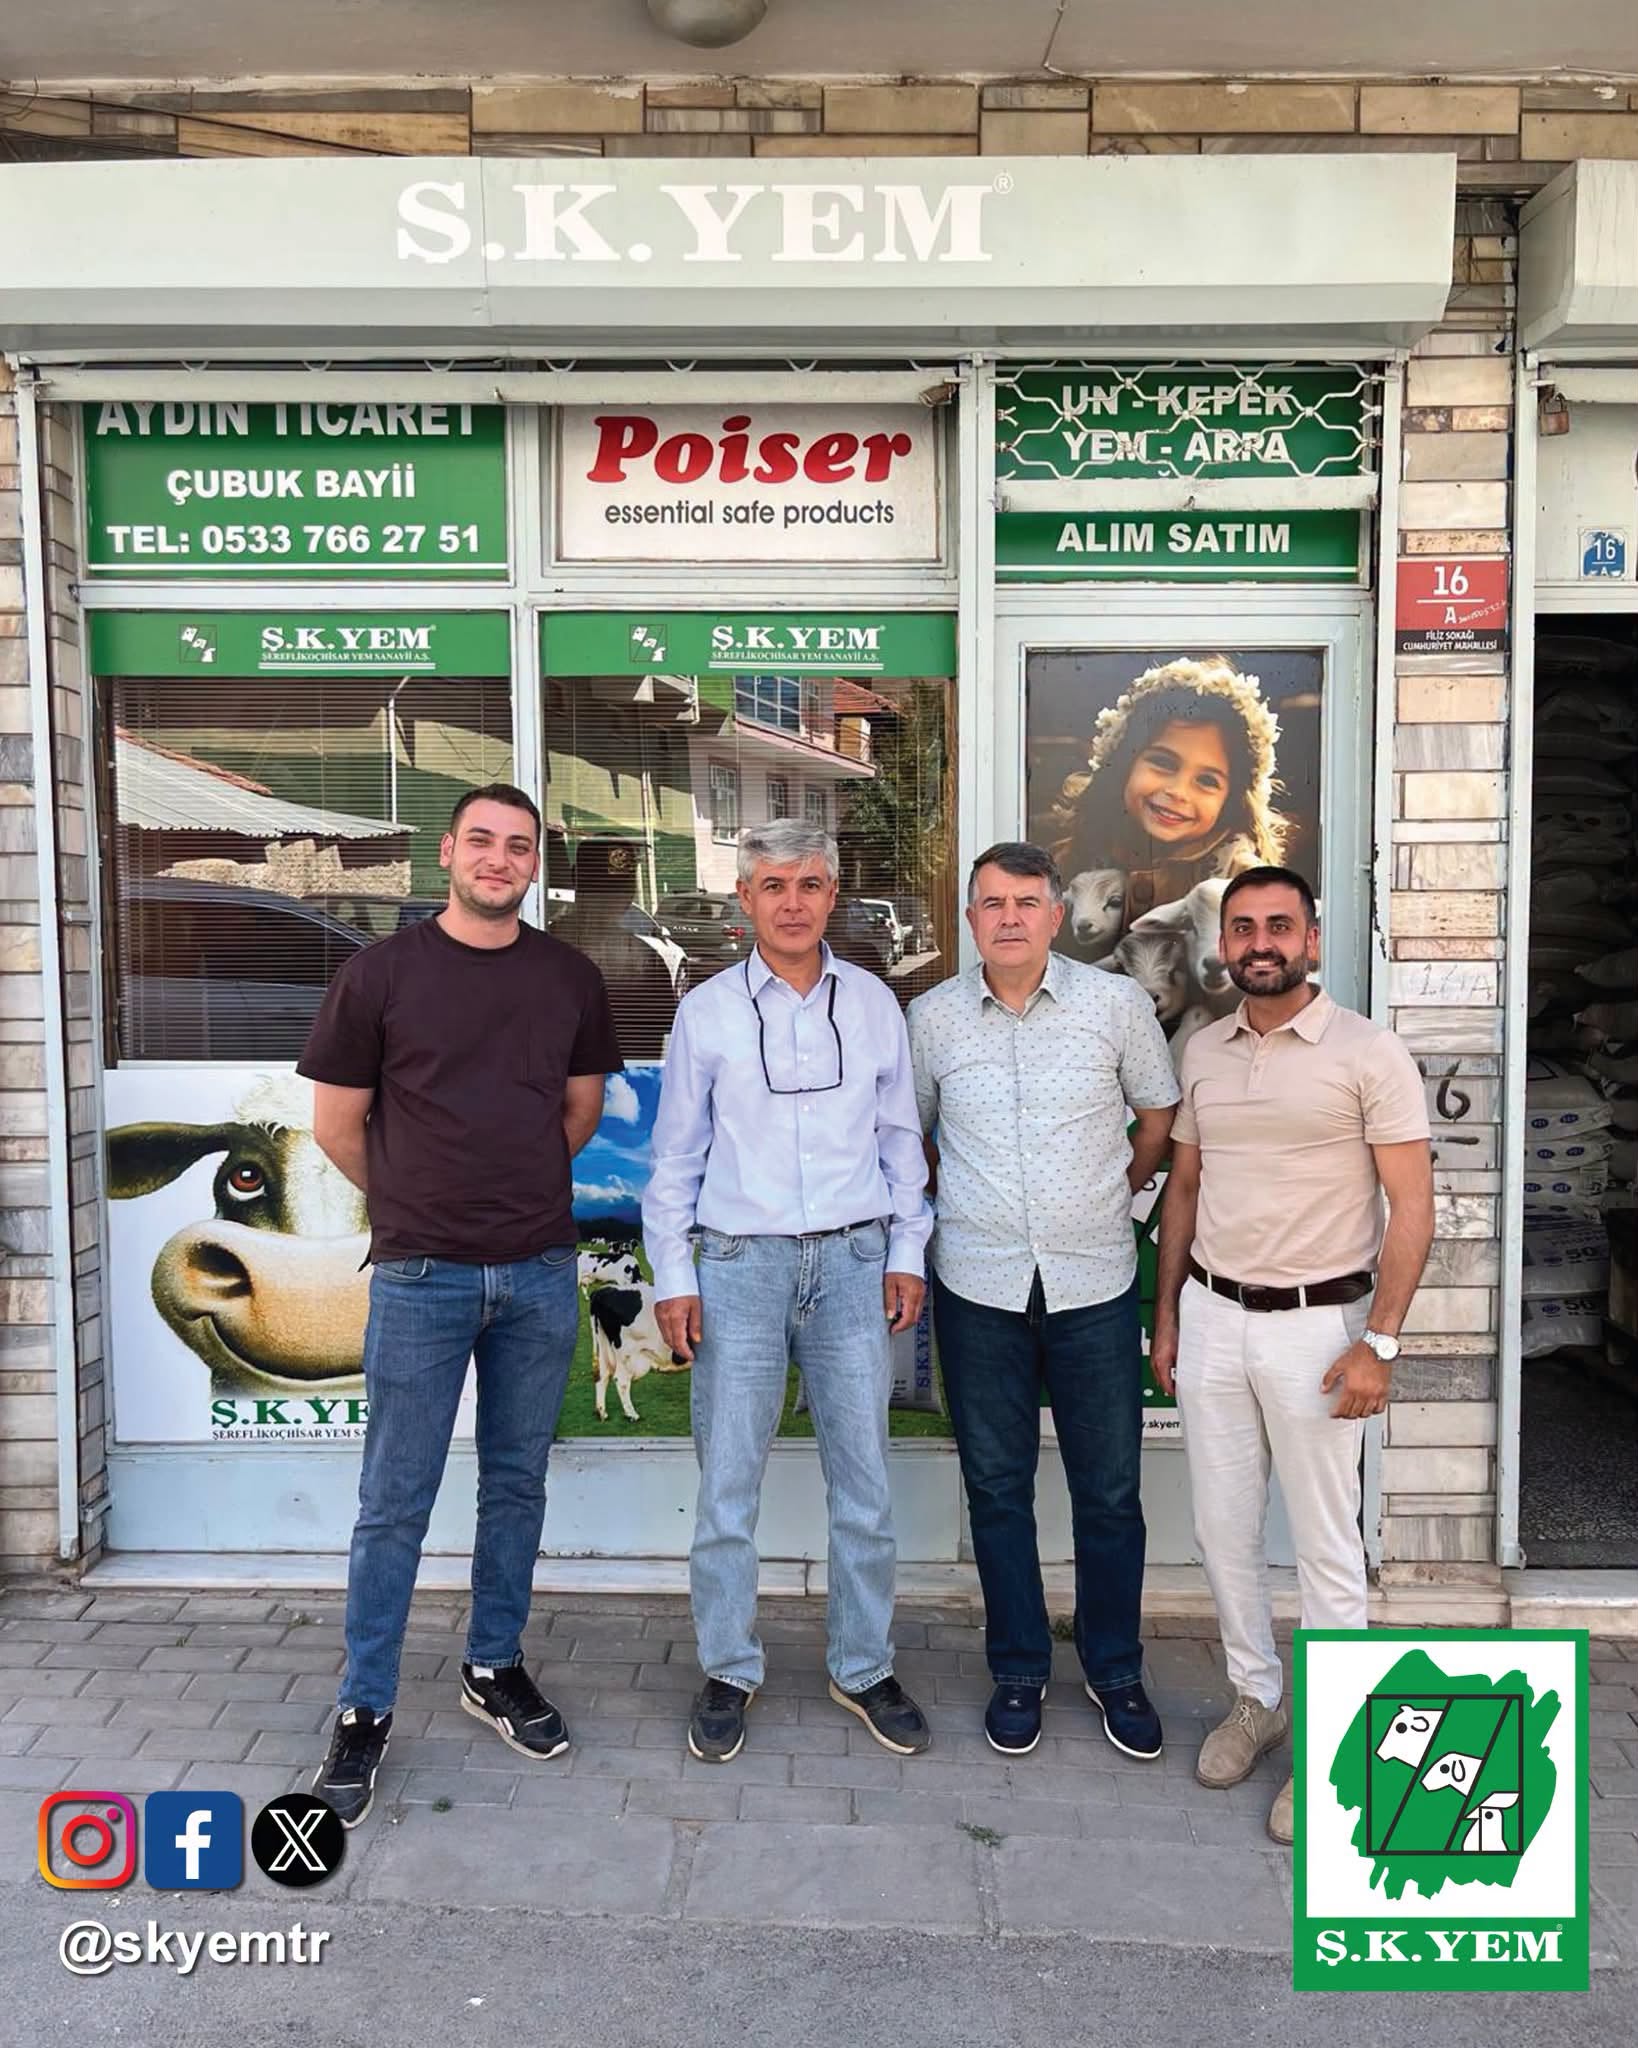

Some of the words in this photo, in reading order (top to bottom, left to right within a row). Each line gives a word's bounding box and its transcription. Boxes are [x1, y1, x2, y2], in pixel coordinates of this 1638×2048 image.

[1062, 386, 1119, 416] UN
[1158, 386, 1293, 416] KEPEK
[95, 402, 249, 436] AYDIN
[586, 415, 912, 484] Poiser
[1062, 431, 1148, 462] YEM
[1184, 431, 1290, 462] ARPA
[167, 469, 303, 506] ÇUBUK
[605, 500, 713, 525] essential
[722, 500, 775, 525] safe
[783, 500, 895, 529] products
[107, 526, 190, 553] TEL:
[202, 526, 292, 553] 0533
[303, 526, 370, 553] 766
[382, 526, 426, 553] 27
[439, 526, 479, 553] 51
[1056, 523, 1154, 553] ALIM
[1168, 522, 1290, 553] SATIM
[1593, 538, 1616, 561] 16
[1432, 565, 1469, 595] 16
[1443, 605, 1457, 624] A
[1403, 641, 1453, 651] CUMHURİYET
[1425, 631, 1444, 640] FİLİZ
[1445, 629, 1475, 640] SOKAĞI
[211, 1397, 369, 1428] Ş.K.YE
[325, 1429, 351, 1438] YEM
